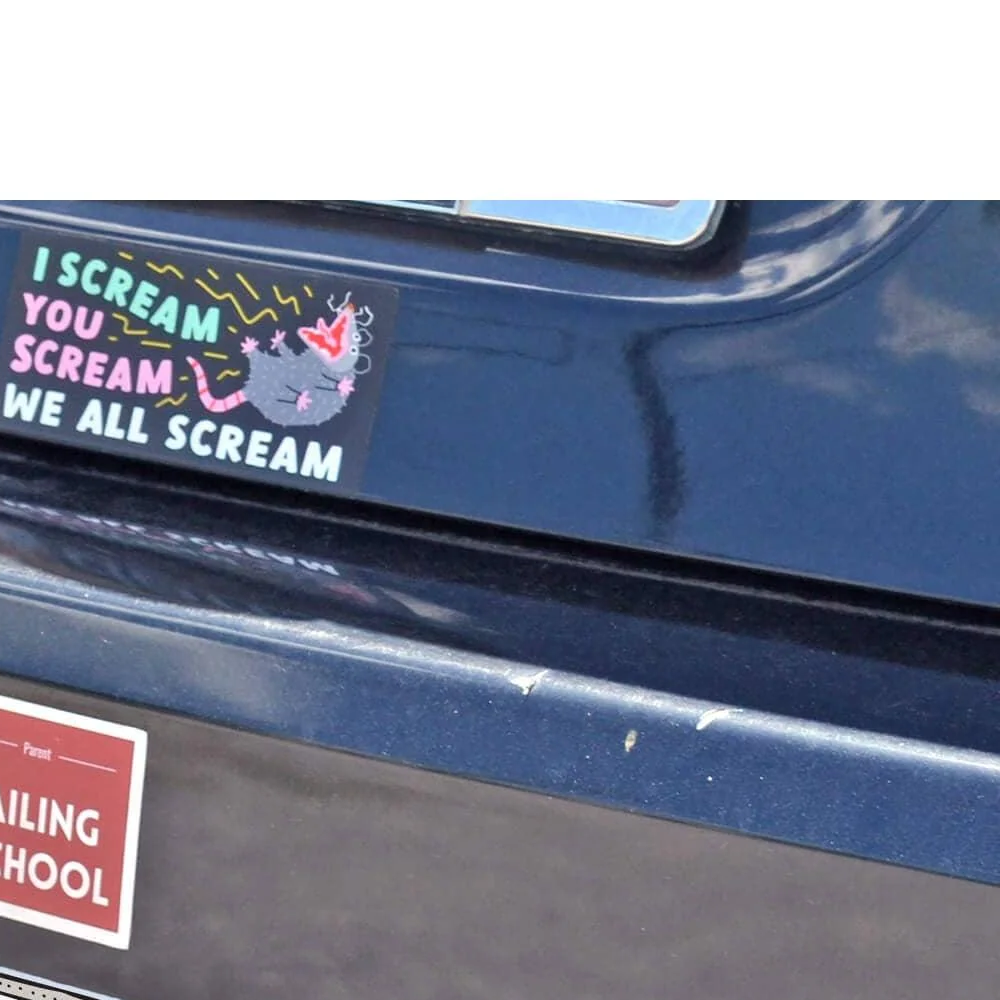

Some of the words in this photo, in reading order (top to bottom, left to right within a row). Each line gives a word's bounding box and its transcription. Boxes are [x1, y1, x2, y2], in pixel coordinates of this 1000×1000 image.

[23, 292, 104, 340] YOU
[33, 247, 50, 282] I
[57, 252, 220, 343] SCREAM
[10, 334, 172, 394] SCREAM
[3, 382, 66, 427] WE
[75, 398, 149, 444] ALL
[165, 414, 343, 482] SCREAM
[23, 741, 53, 761] Parent
